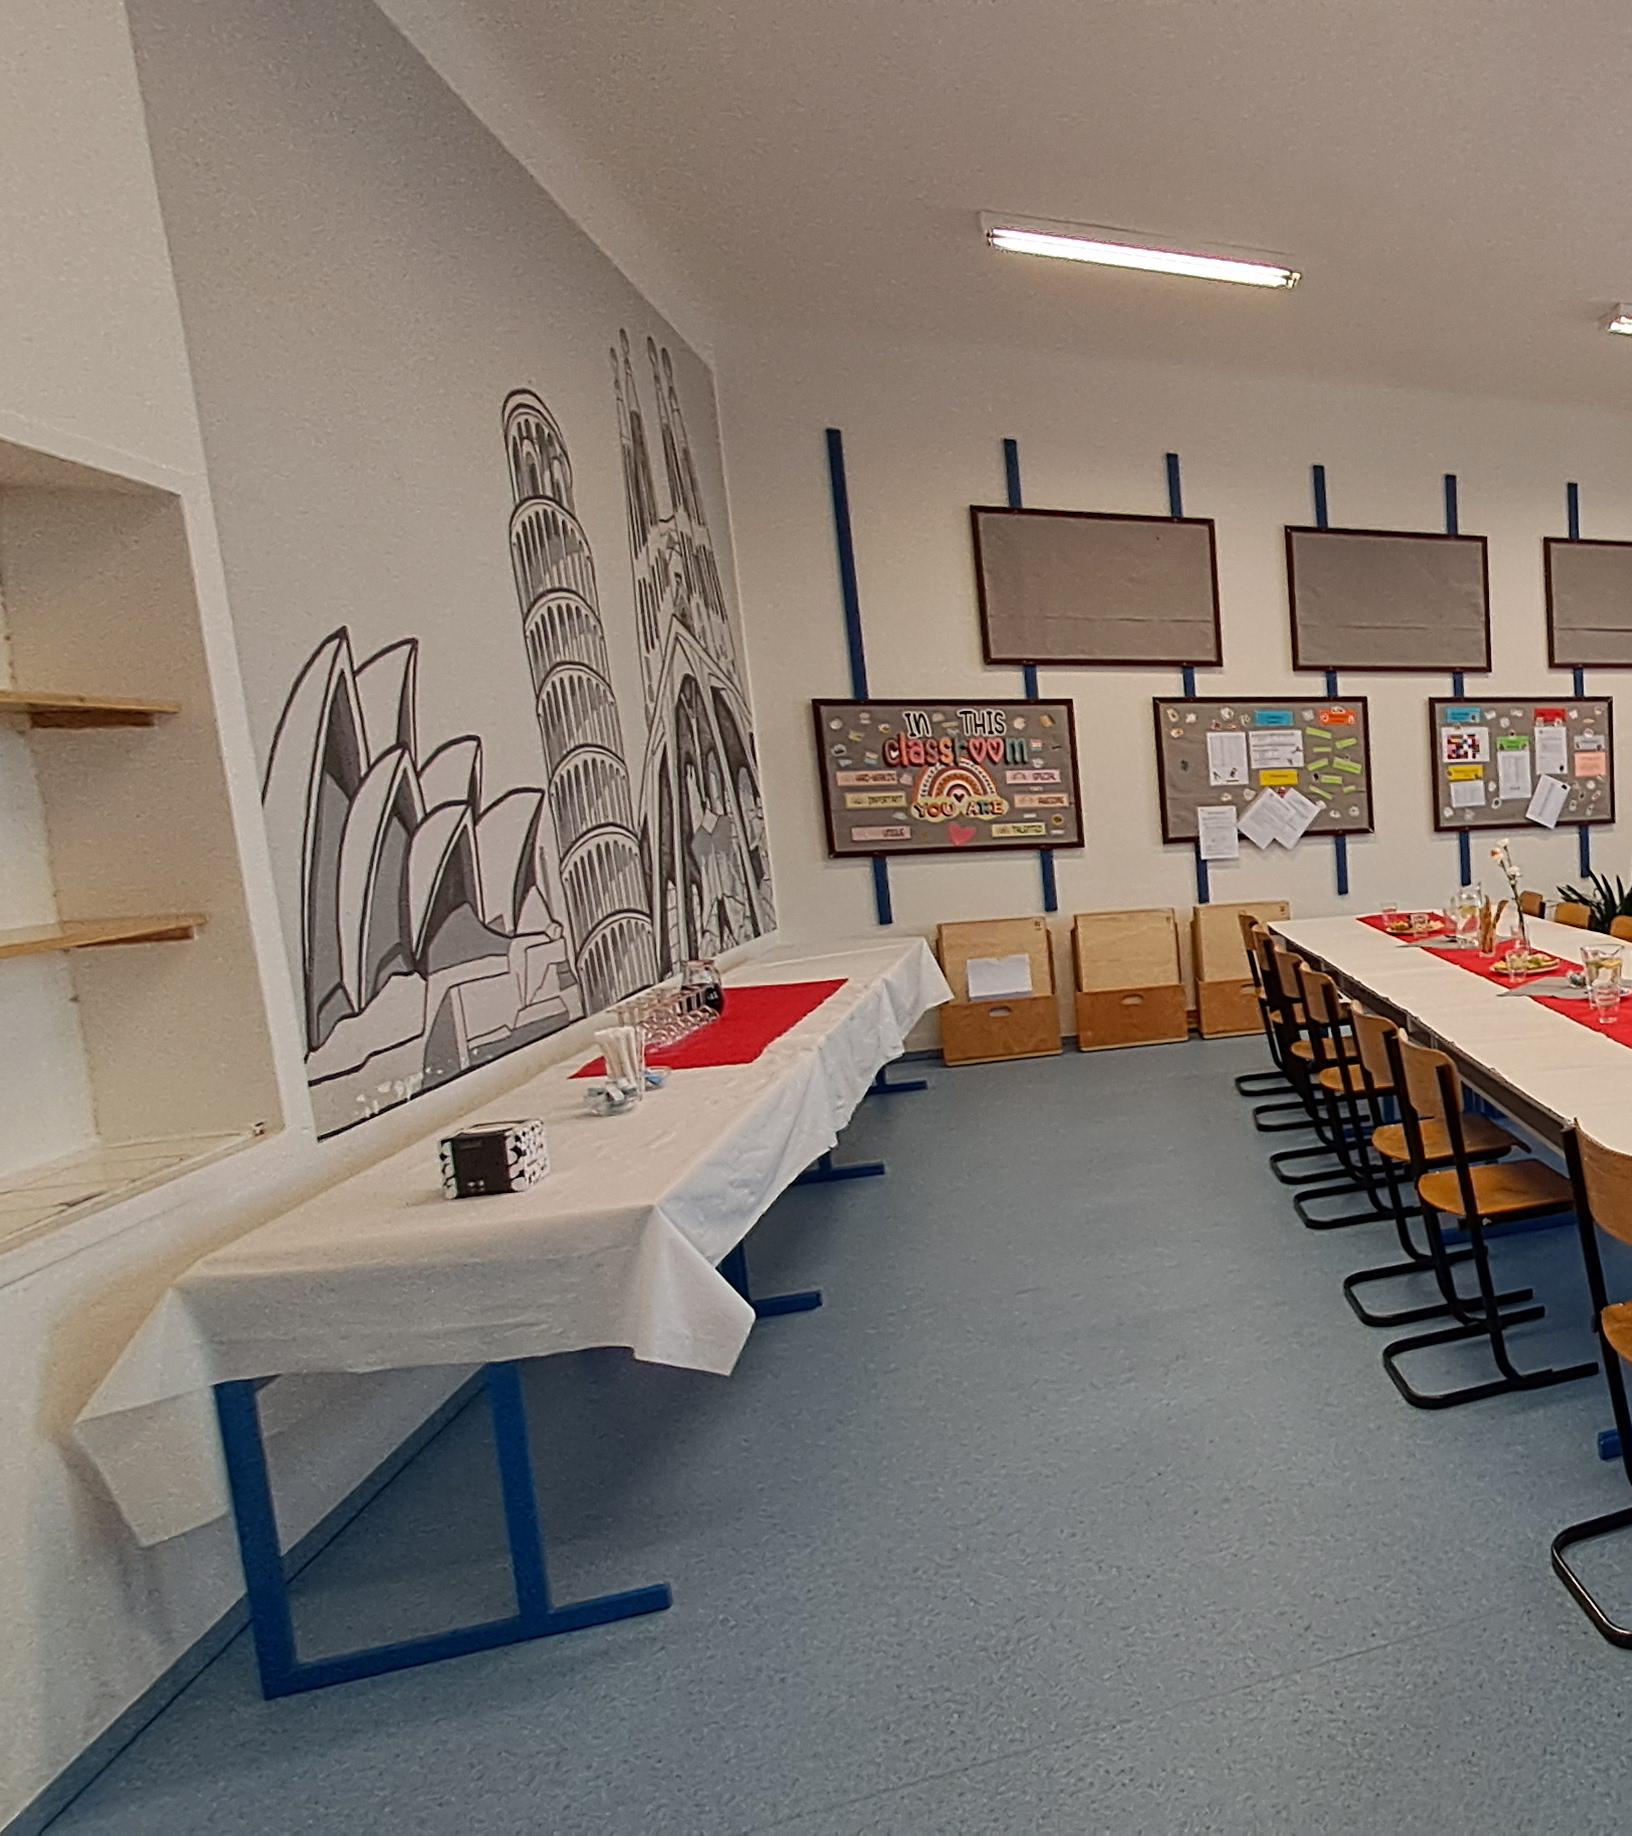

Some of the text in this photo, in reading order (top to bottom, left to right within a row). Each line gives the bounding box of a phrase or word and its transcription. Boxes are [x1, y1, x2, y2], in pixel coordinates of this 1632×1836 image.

[903, 709, 1006, 738] IN THIS
[883, 731, 1028, 767] classroom
[913, 800, 1004, 818] YOU ARE
